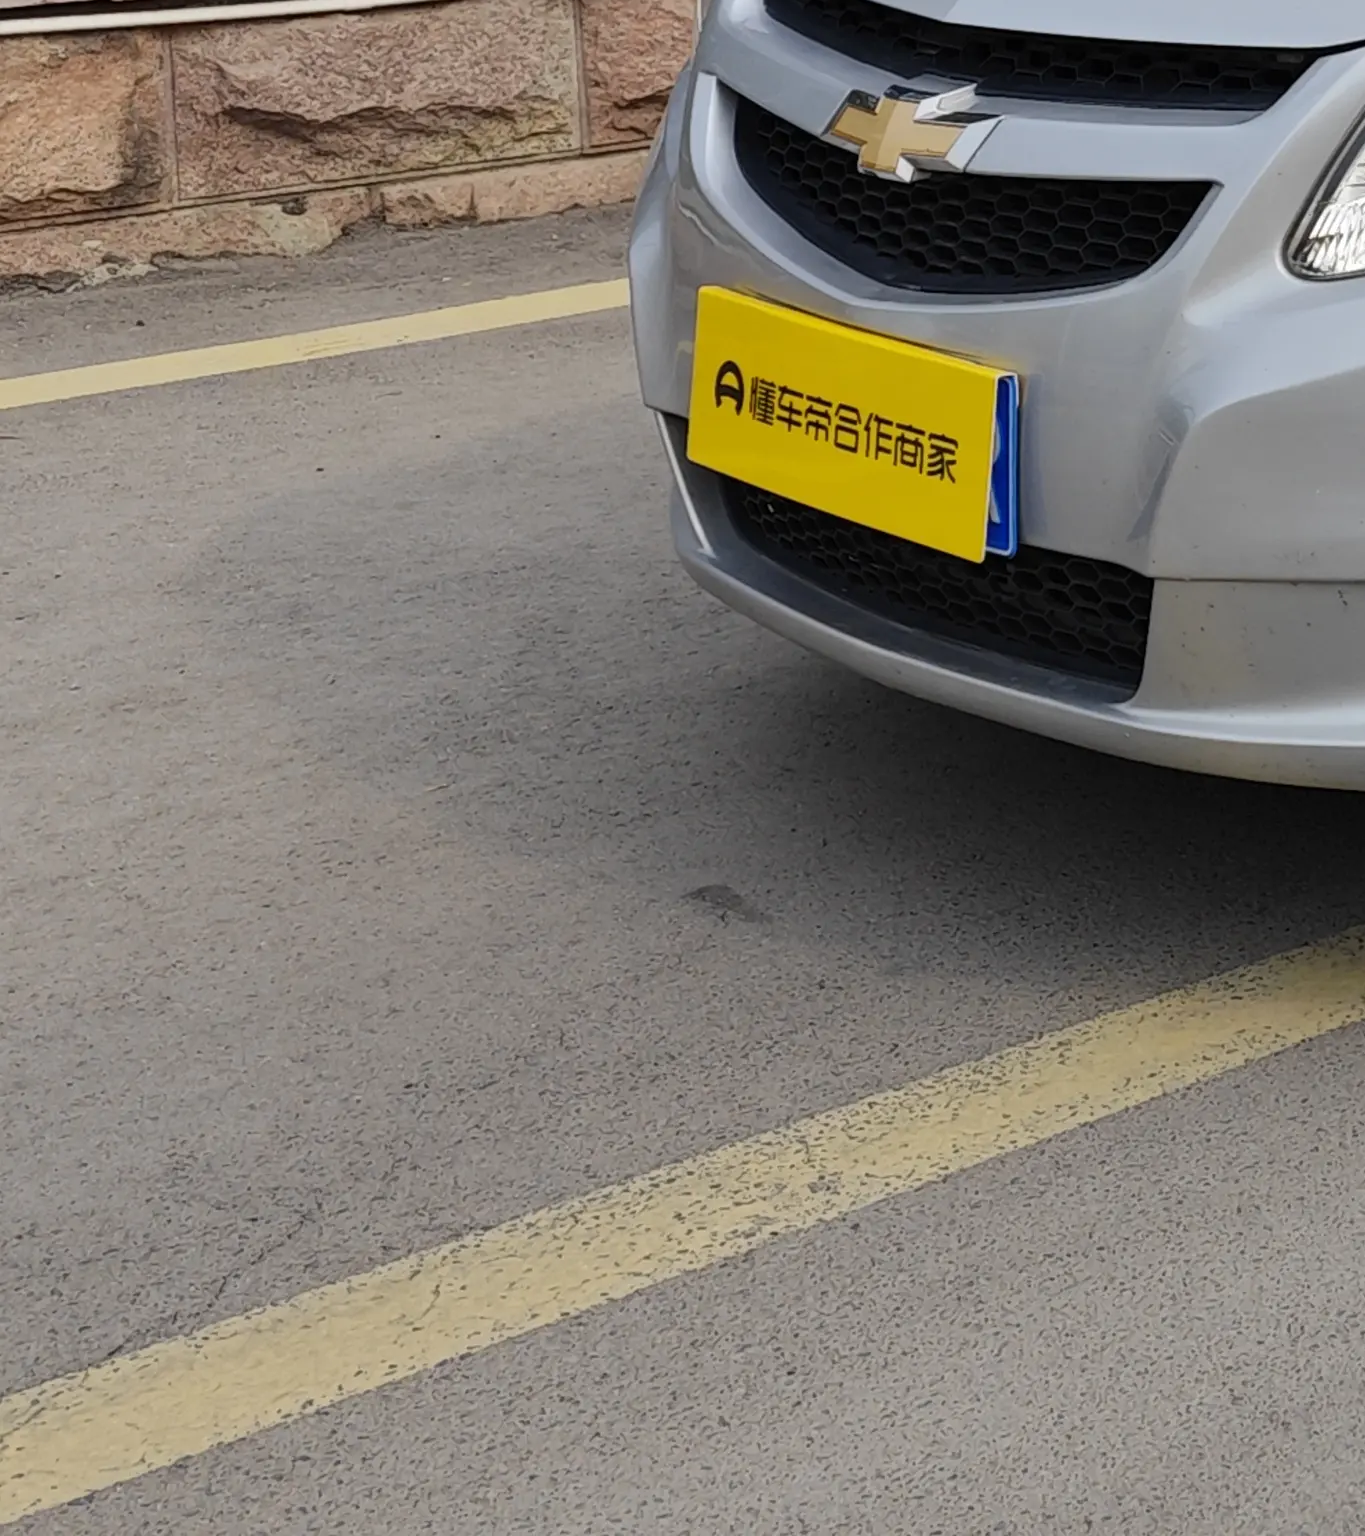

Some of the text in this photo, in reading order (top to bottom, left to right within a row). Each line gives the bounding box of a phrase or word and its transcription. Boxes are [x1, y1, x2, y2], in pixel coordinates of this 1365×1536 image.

[749, 376, 960, 484] 懂车帝合作商家
